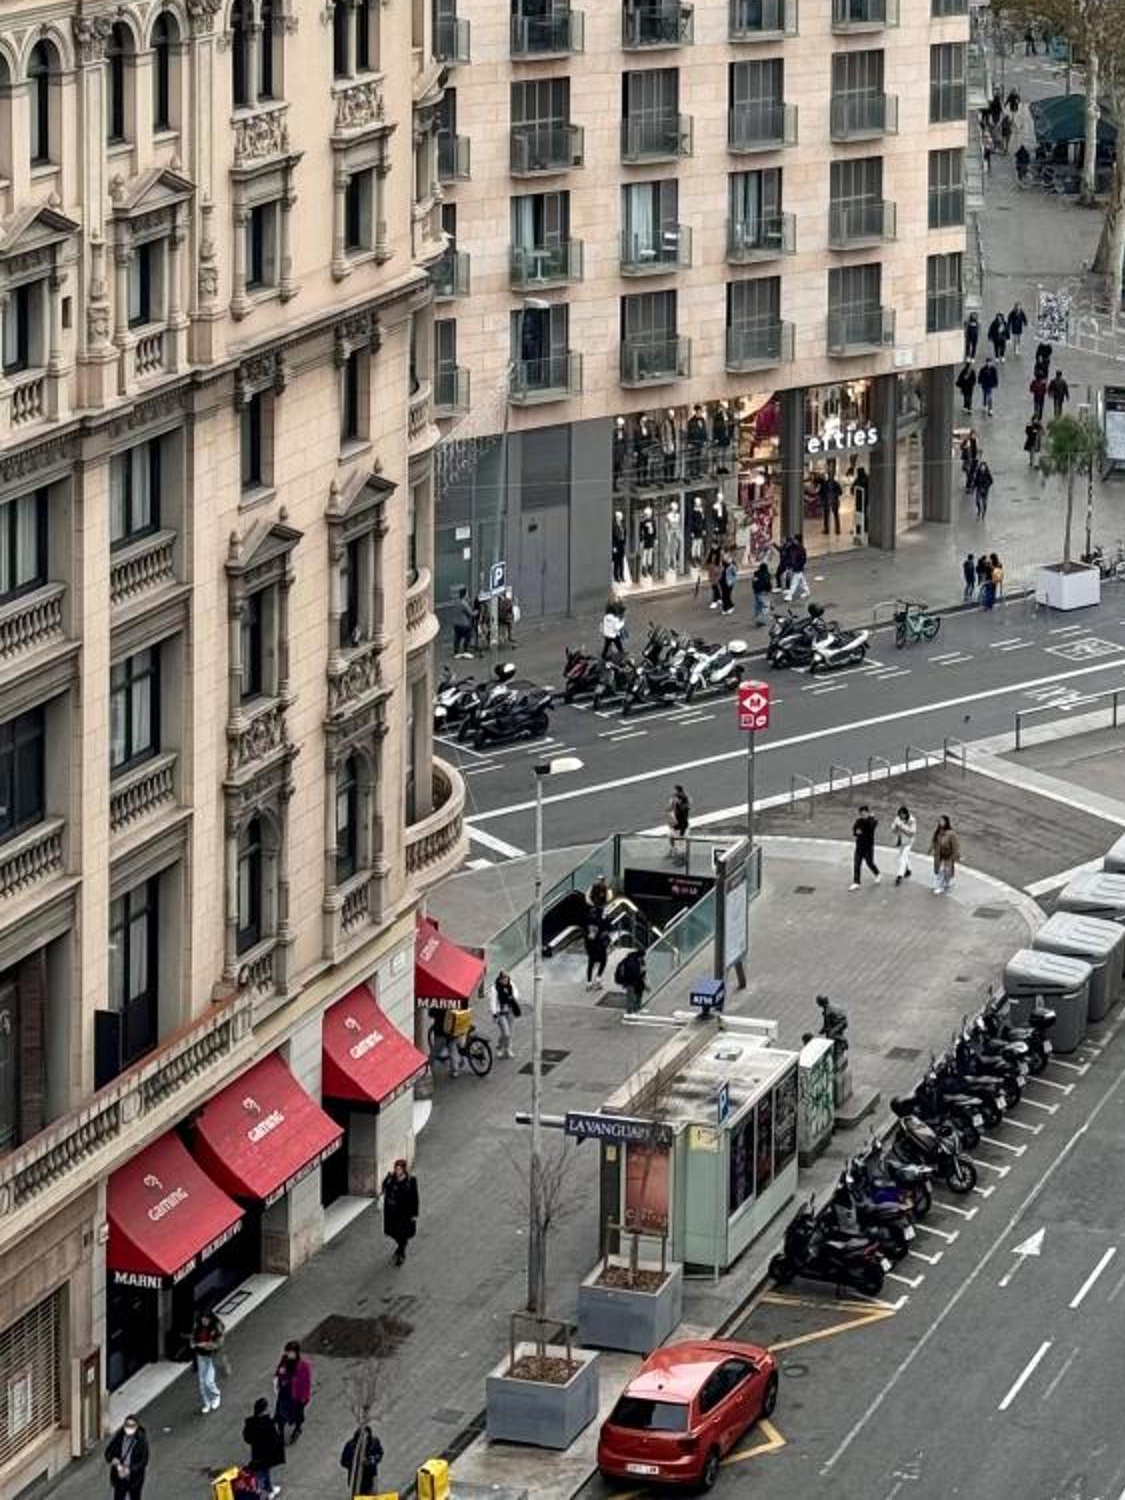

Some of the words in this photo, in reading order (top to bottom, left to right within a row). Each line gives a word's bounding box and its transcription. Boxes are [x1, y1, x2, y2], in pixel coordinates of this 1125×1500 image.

[417, 998, 462, 1010] MARNI
[568, 1118, 586, 1133] LA
[586, 1121, 669, 1142] VANGUARA
[114, 1271, 162, 1290] MARNI
